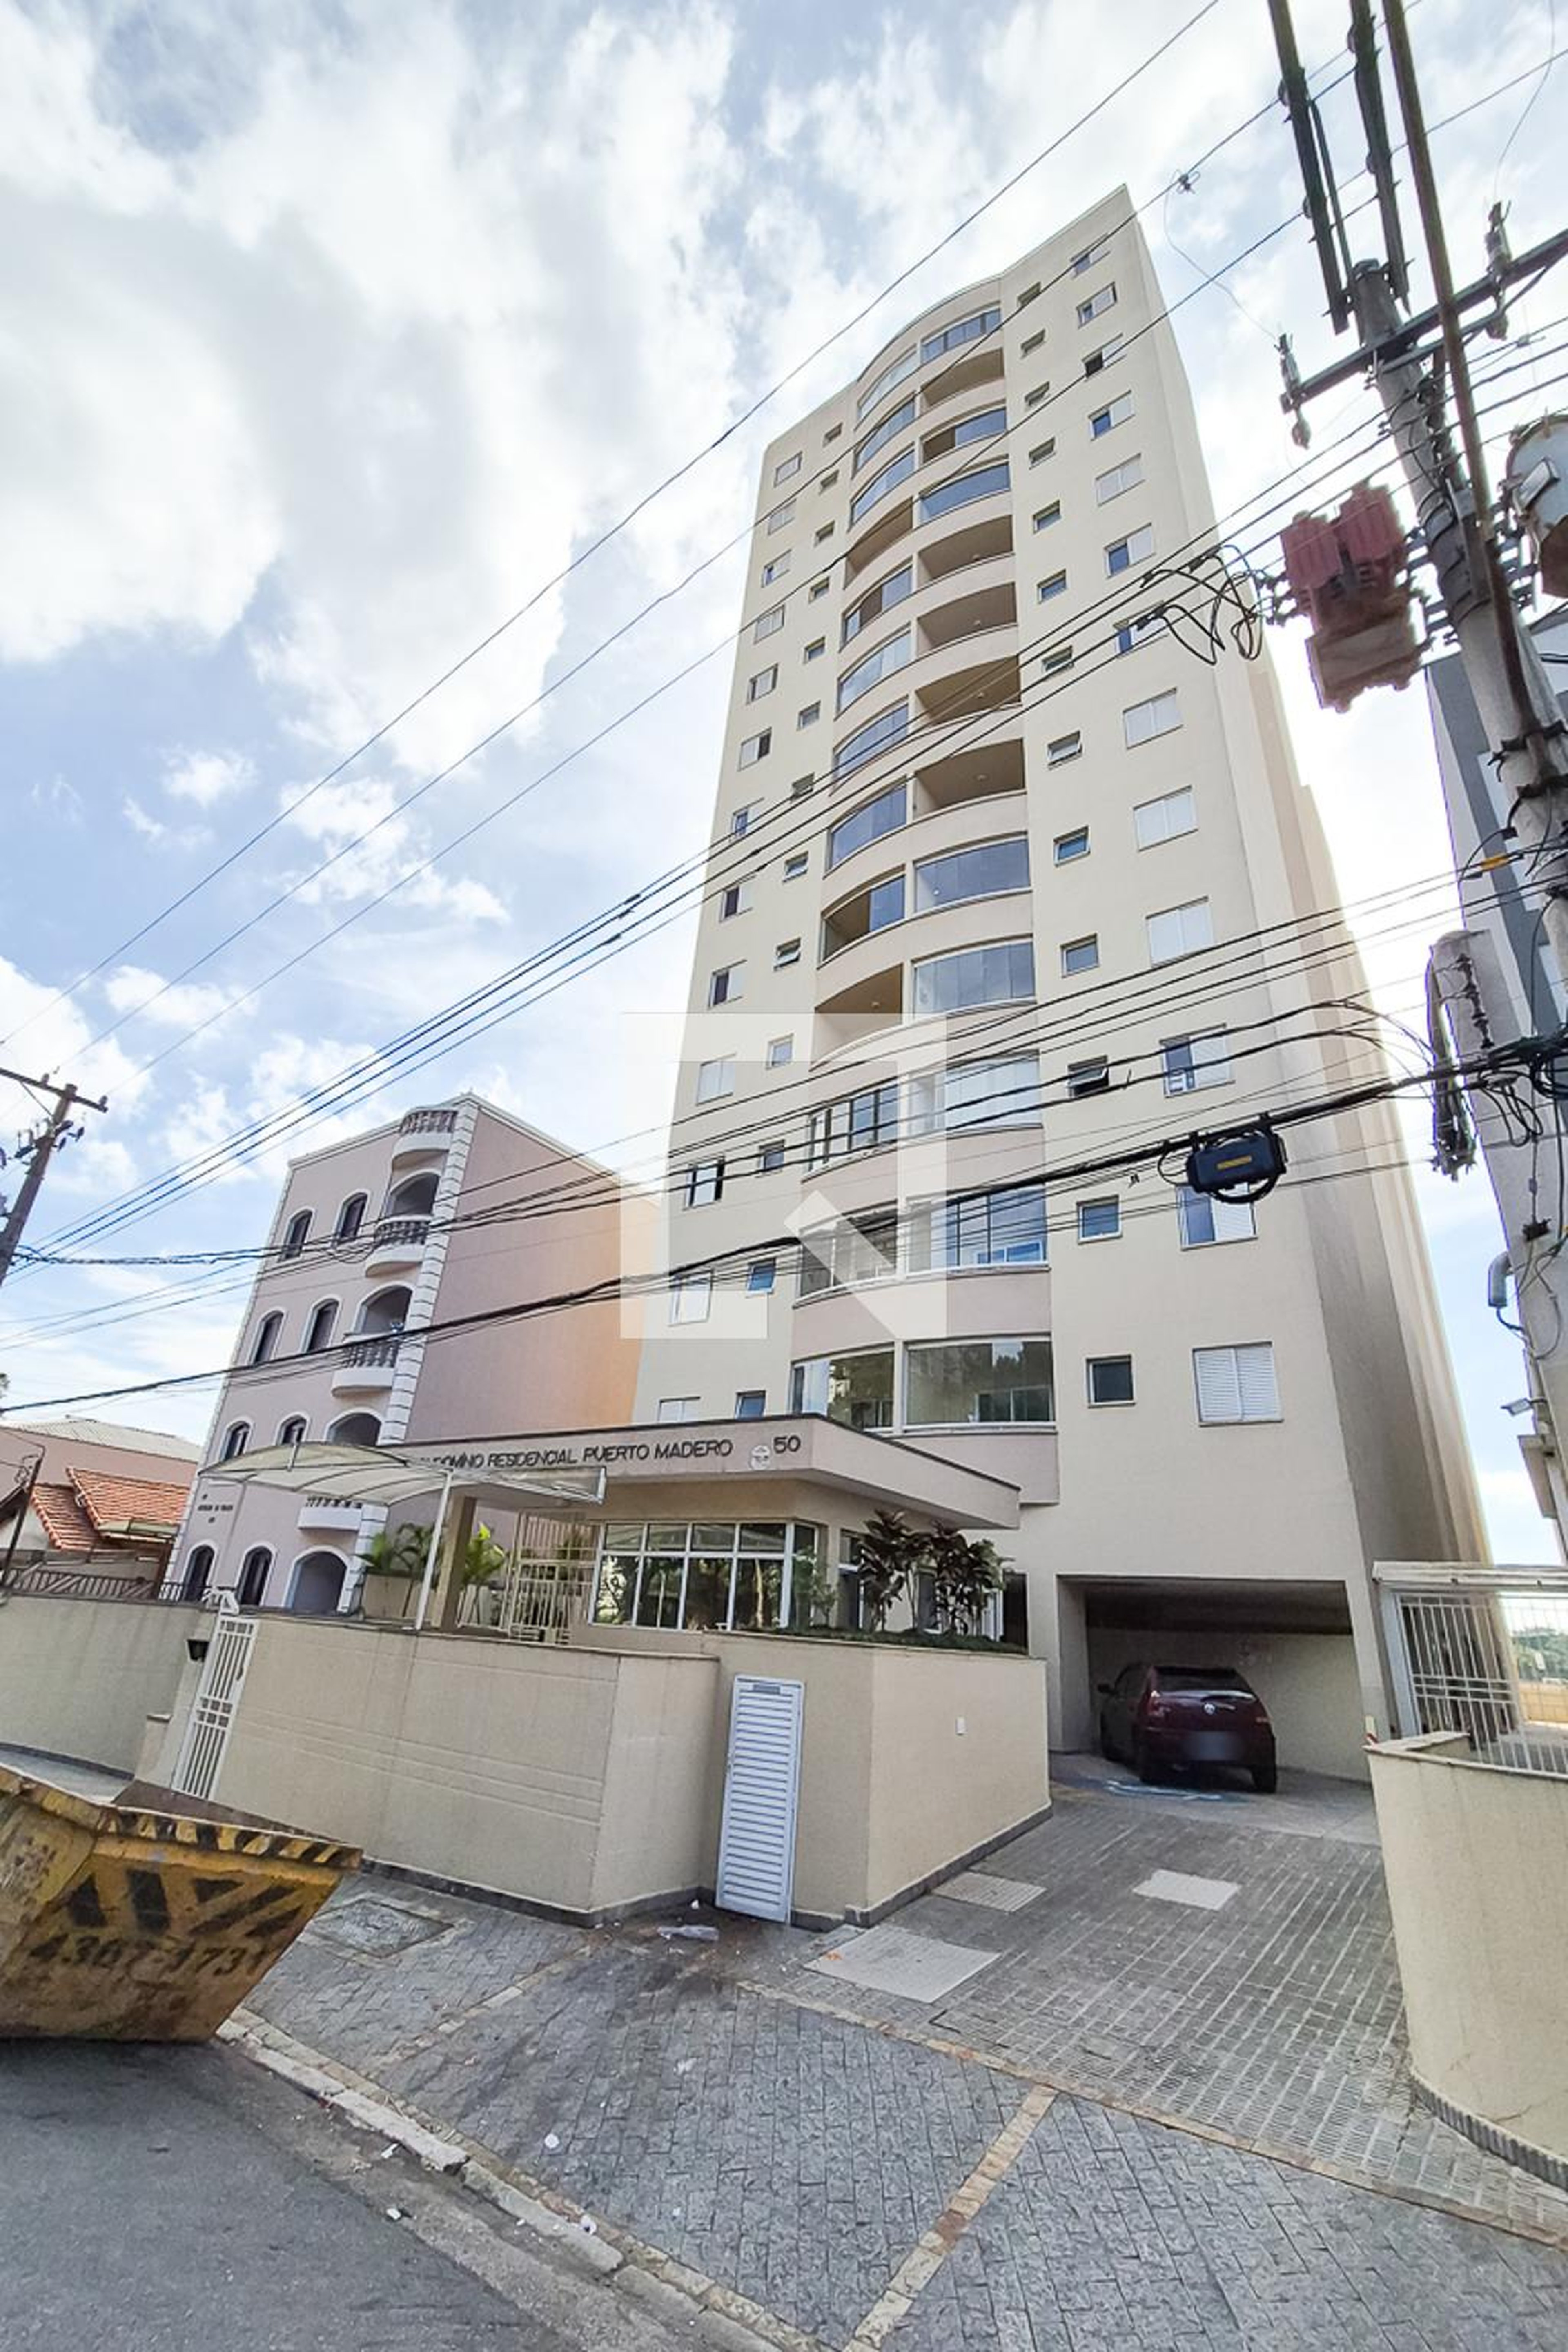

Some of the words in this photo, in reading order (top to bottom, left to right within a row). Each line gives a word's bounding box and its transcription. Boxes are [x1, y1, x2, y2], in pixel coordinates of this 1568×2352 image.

[488, 1449, 577, 1468] RESIDENCIAL
[583, 1444, 650, 1462] PUERTO
[654, 1439, 734, 1459] MADERO
[774, 1435, 801, 1454] 50
